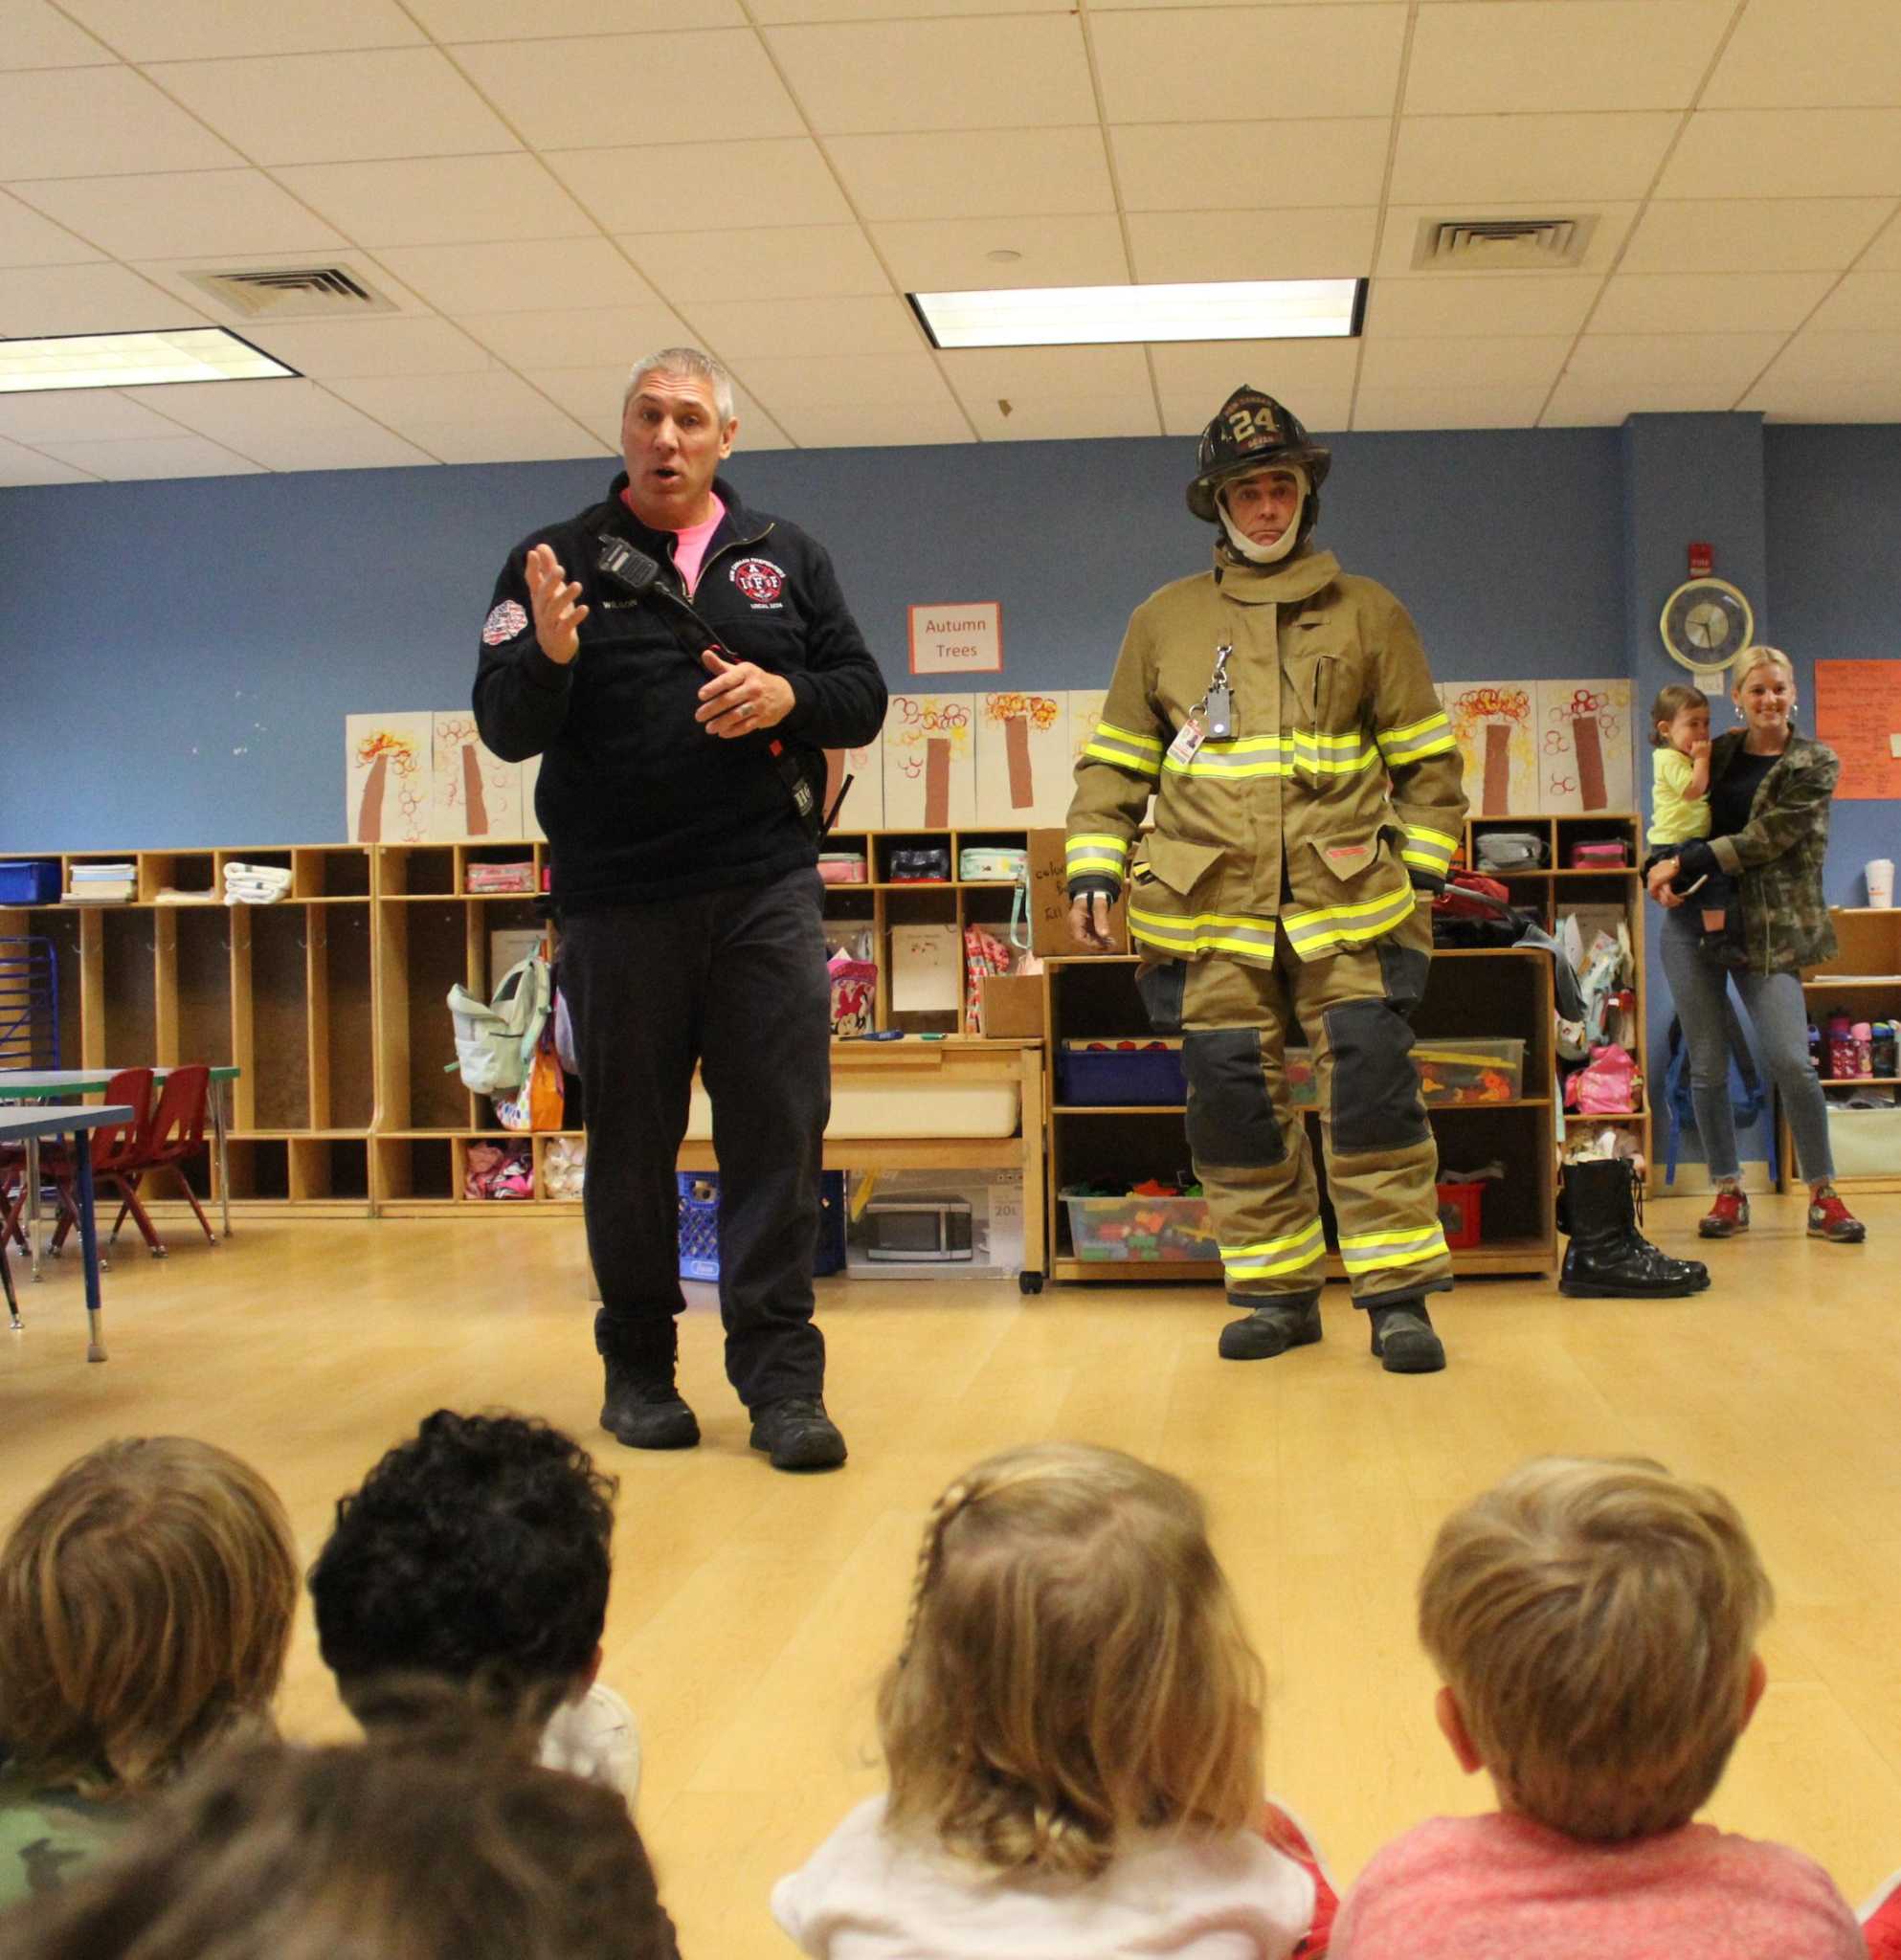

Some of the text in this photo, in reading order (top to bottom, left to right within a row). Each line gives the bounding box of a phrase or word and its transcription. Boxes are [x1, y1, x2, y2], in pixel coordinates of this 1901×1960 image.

[1229, 407, 1278, 444] 24
[925, 619, 986, 633] Autumn
[936, 644, 978, 657] Trees
